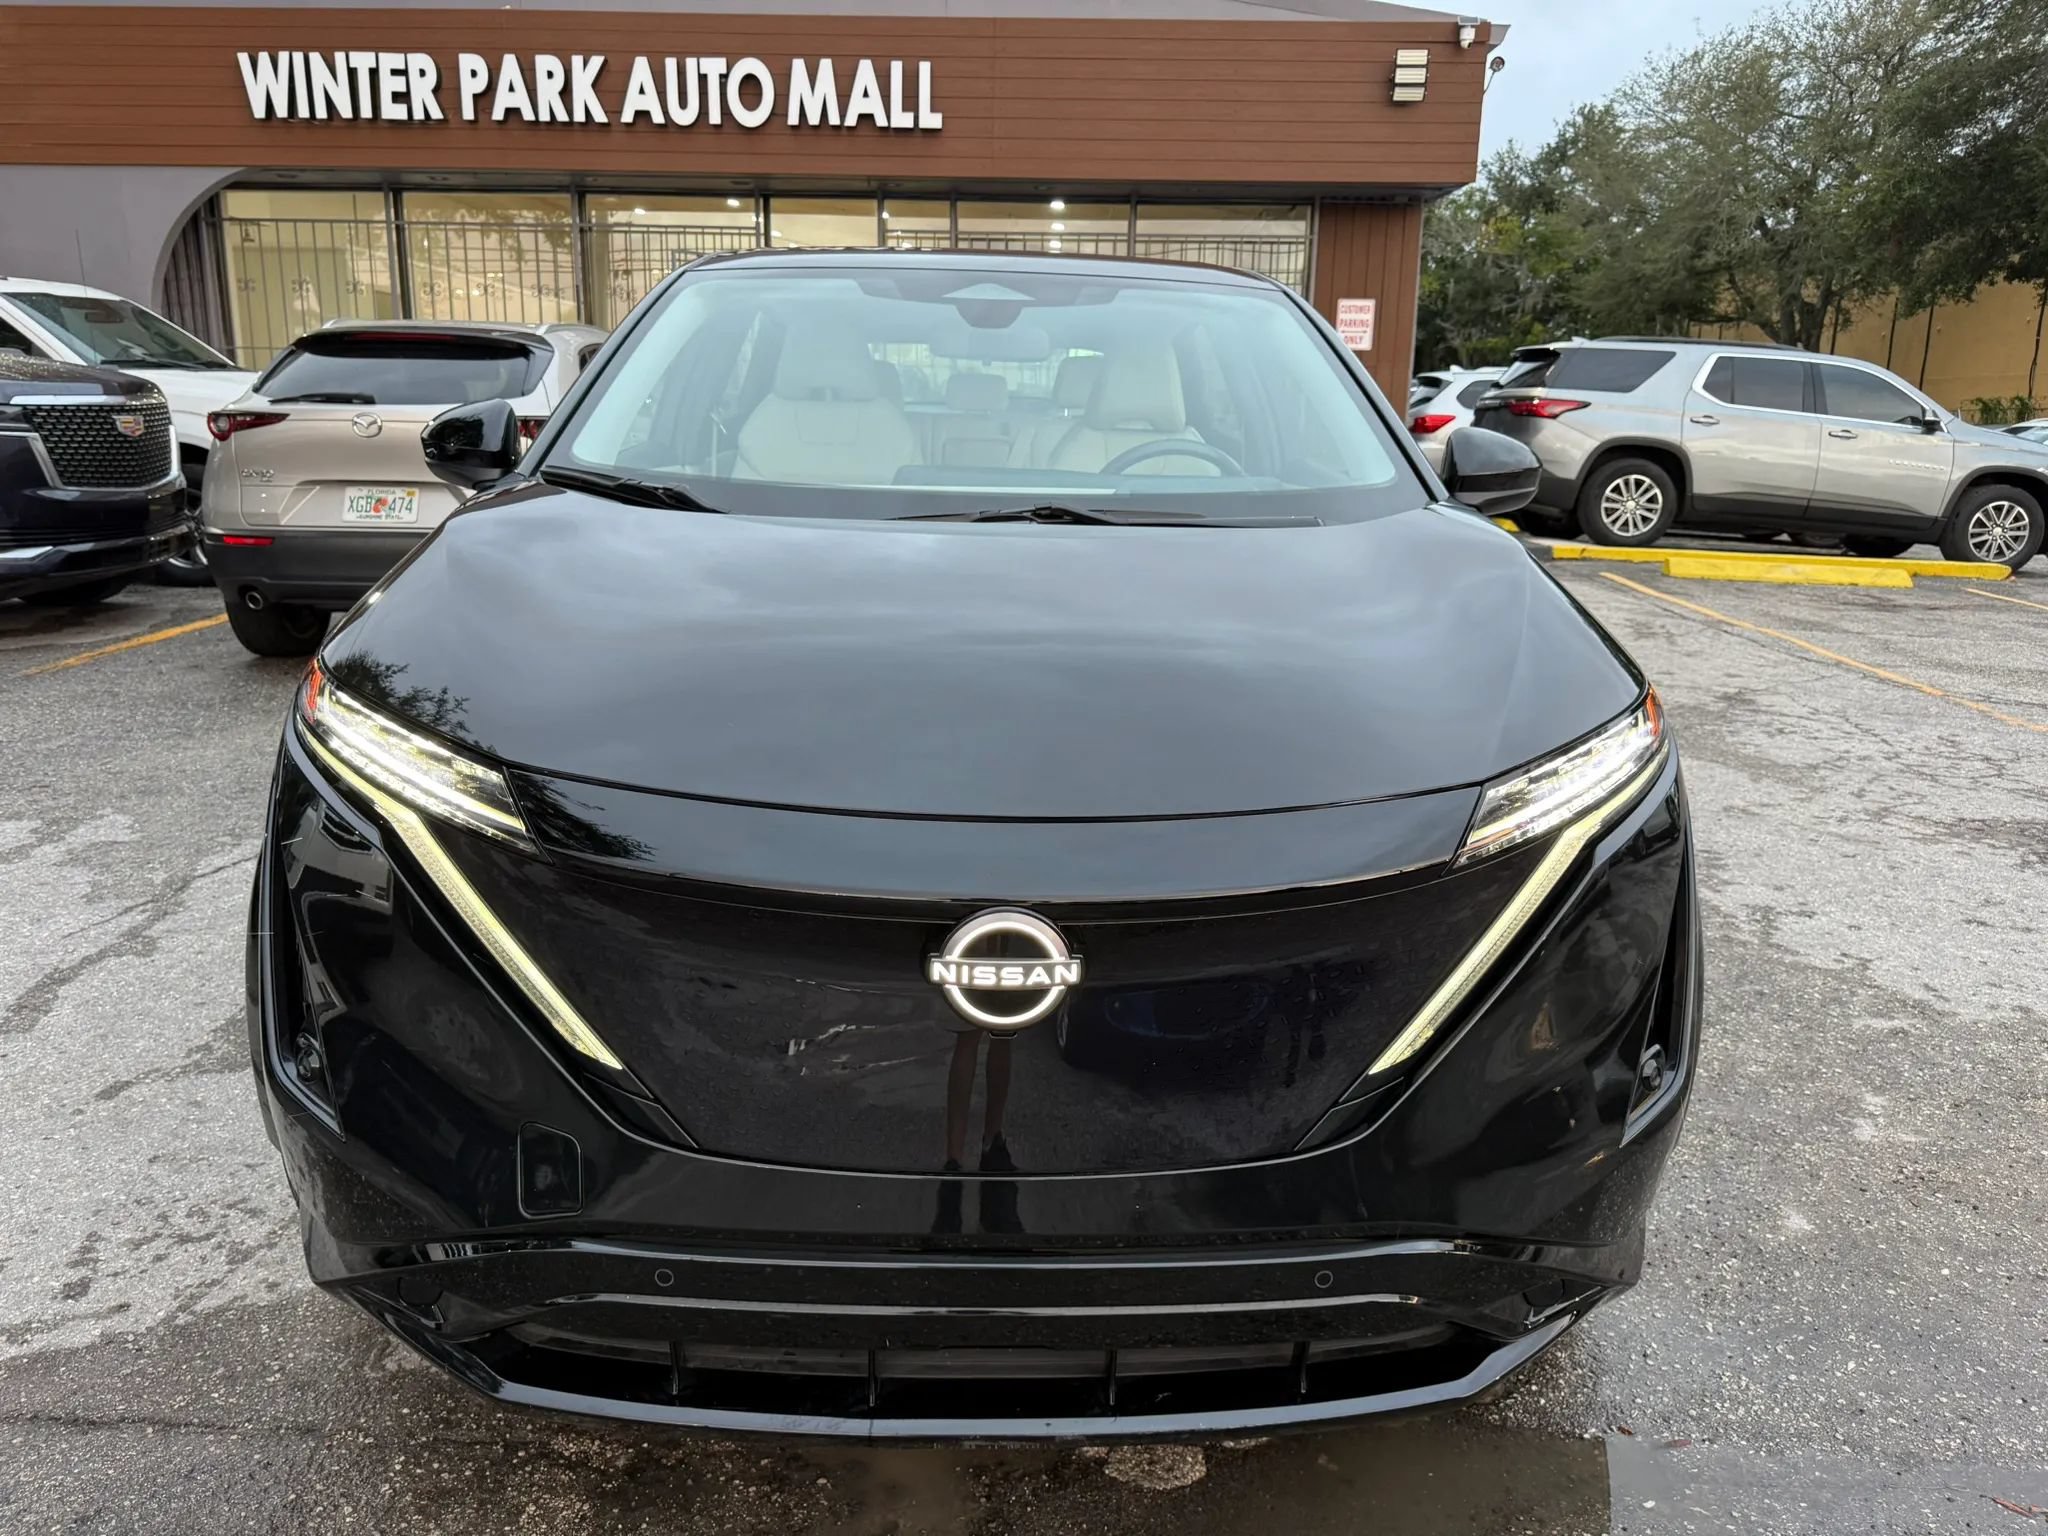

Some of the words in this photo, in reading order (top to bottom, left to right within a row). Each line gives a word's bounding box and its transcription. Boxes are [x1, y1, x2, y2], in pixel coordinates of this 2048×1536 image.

[237, 51, 444, 120] WINTER
[458, 53, 609, 123] PARK
[620, 56, 775, 128] AUTO
[787, 58, 943, 129] MALL
[1340, 304, 1371, 315] CUSTOMER
[1339, 319, 1370, 328] PARKING
[1343, 335, 1363, 345] ONLY
[367, 488, 396, 496] FLORIDA
[932, 961, 1078, 986] NISSAN
